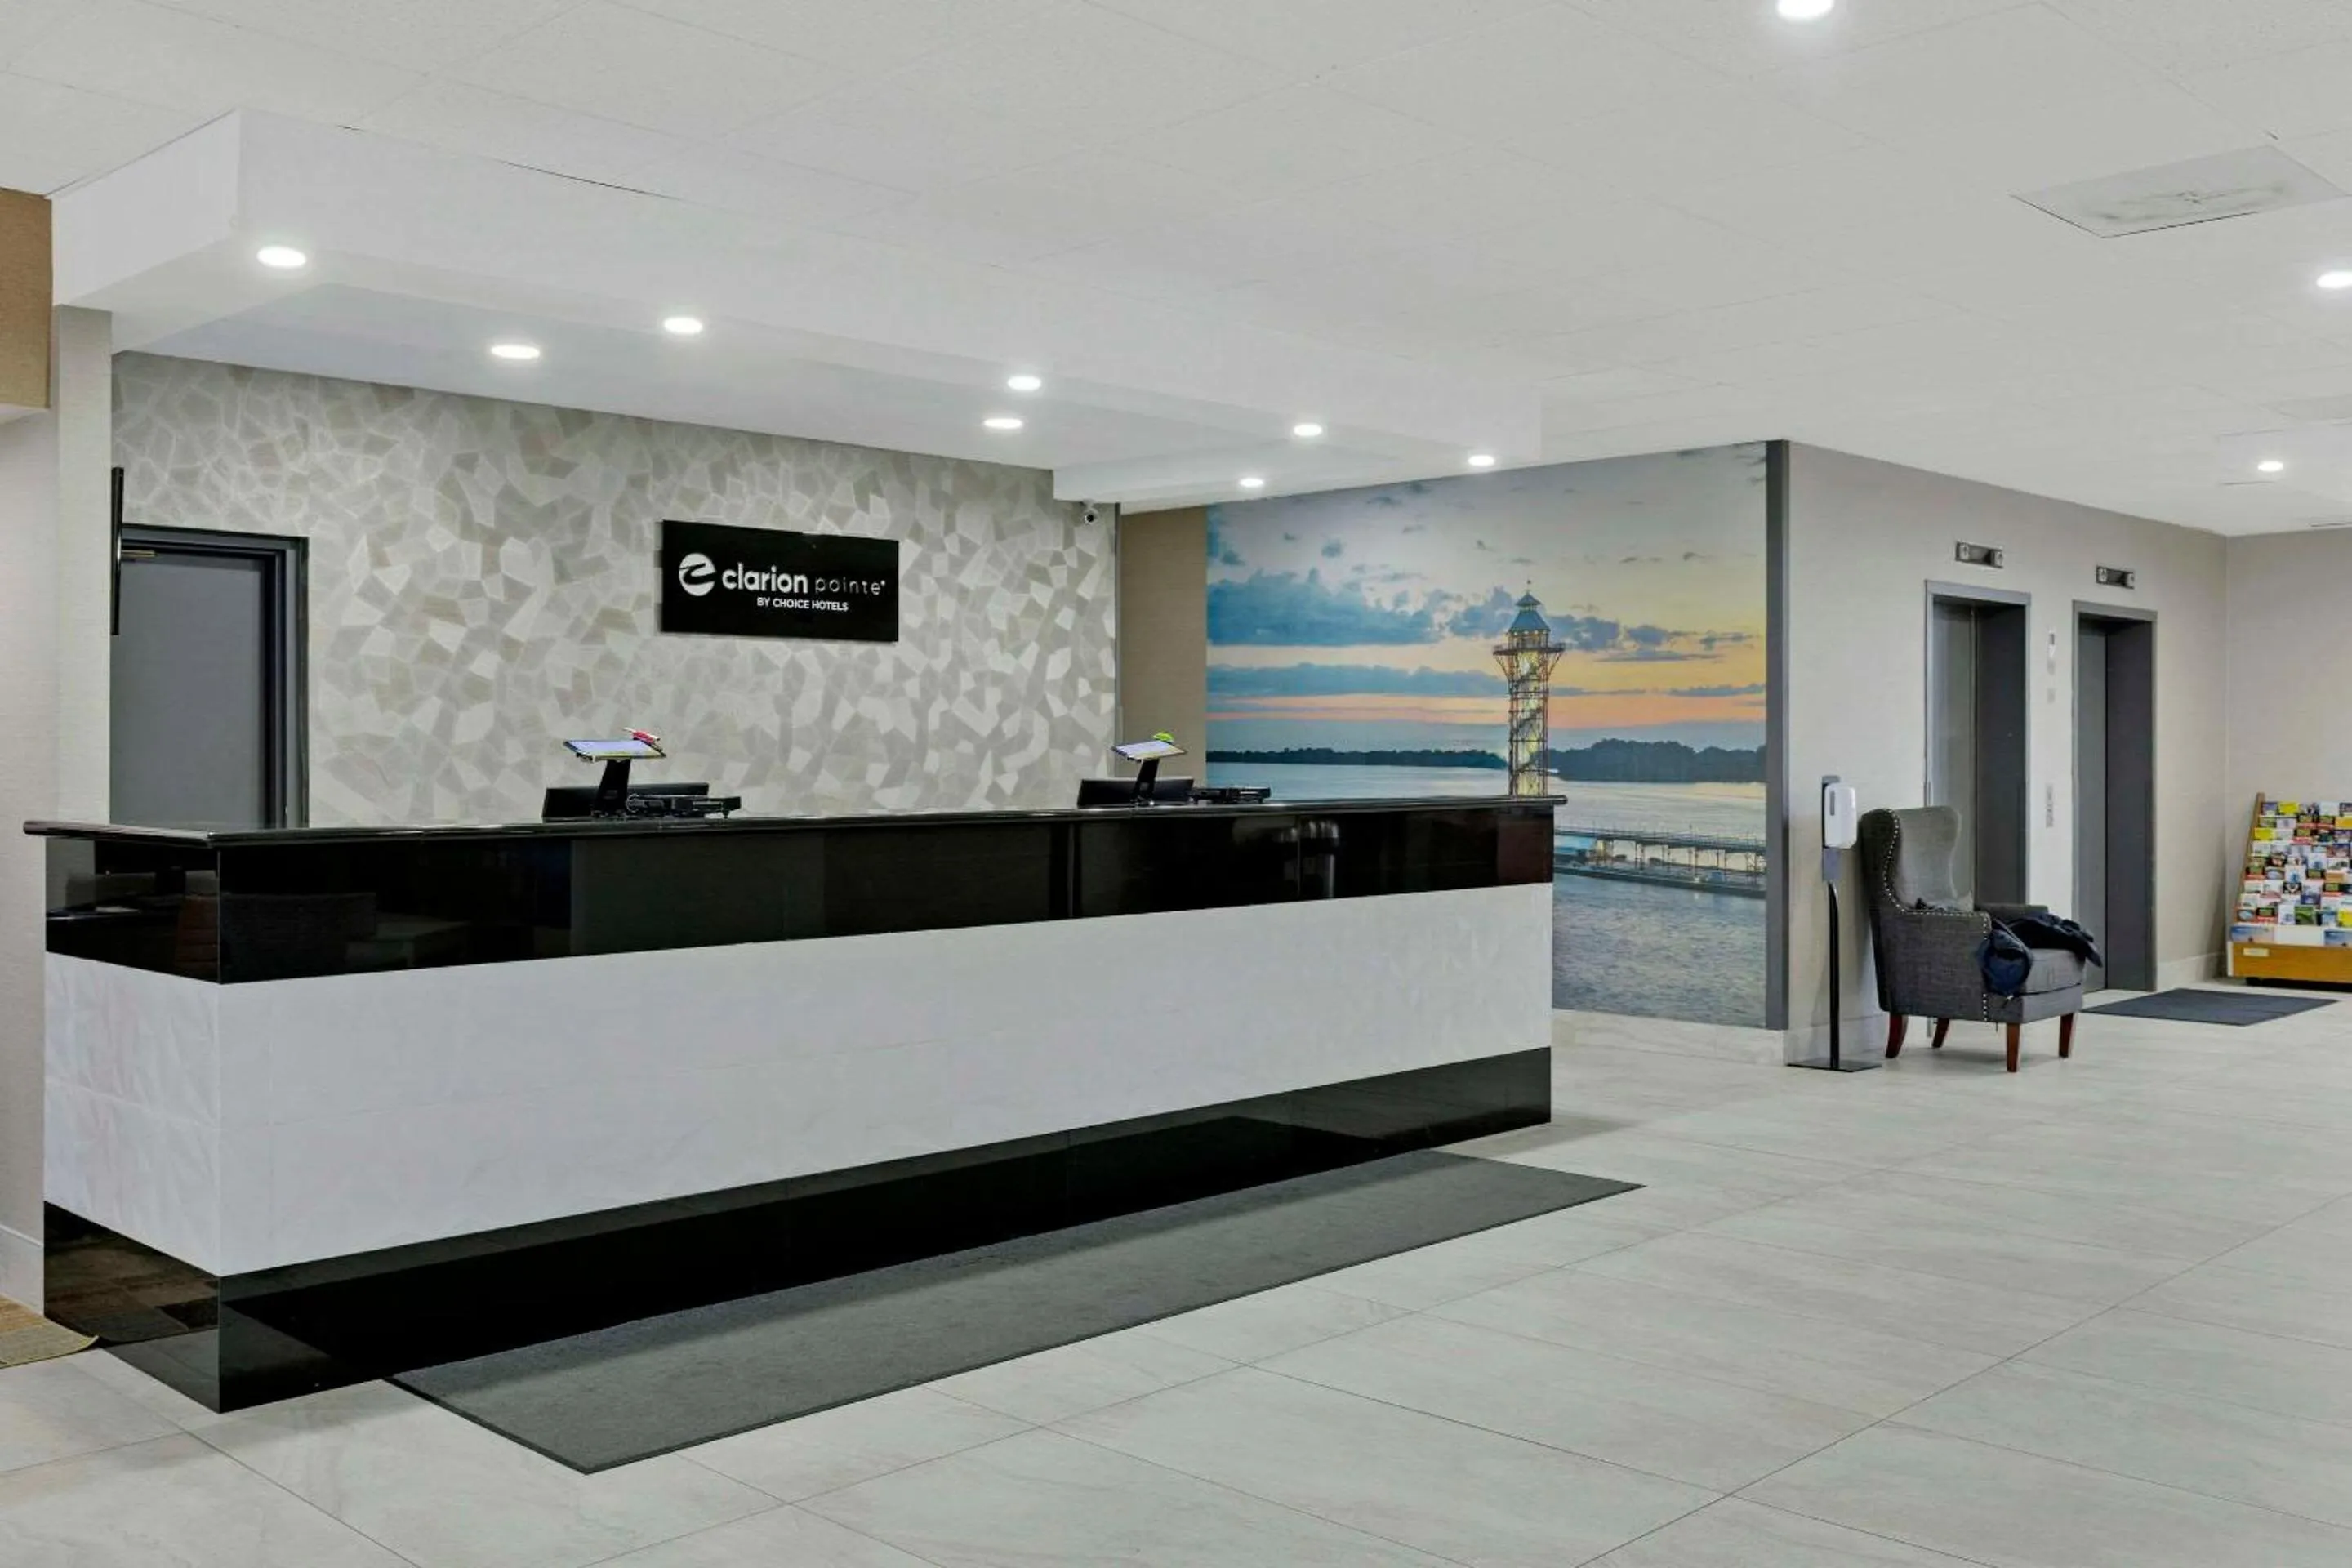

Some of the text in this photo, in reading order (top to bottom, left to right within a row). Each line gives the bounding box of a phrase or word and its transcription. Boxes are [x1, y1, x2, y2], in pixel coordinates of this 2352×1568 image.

[722, 562, 880, 595] clarion pointe
[756, 597, 849, 612] BY CHOICE HOTELS
